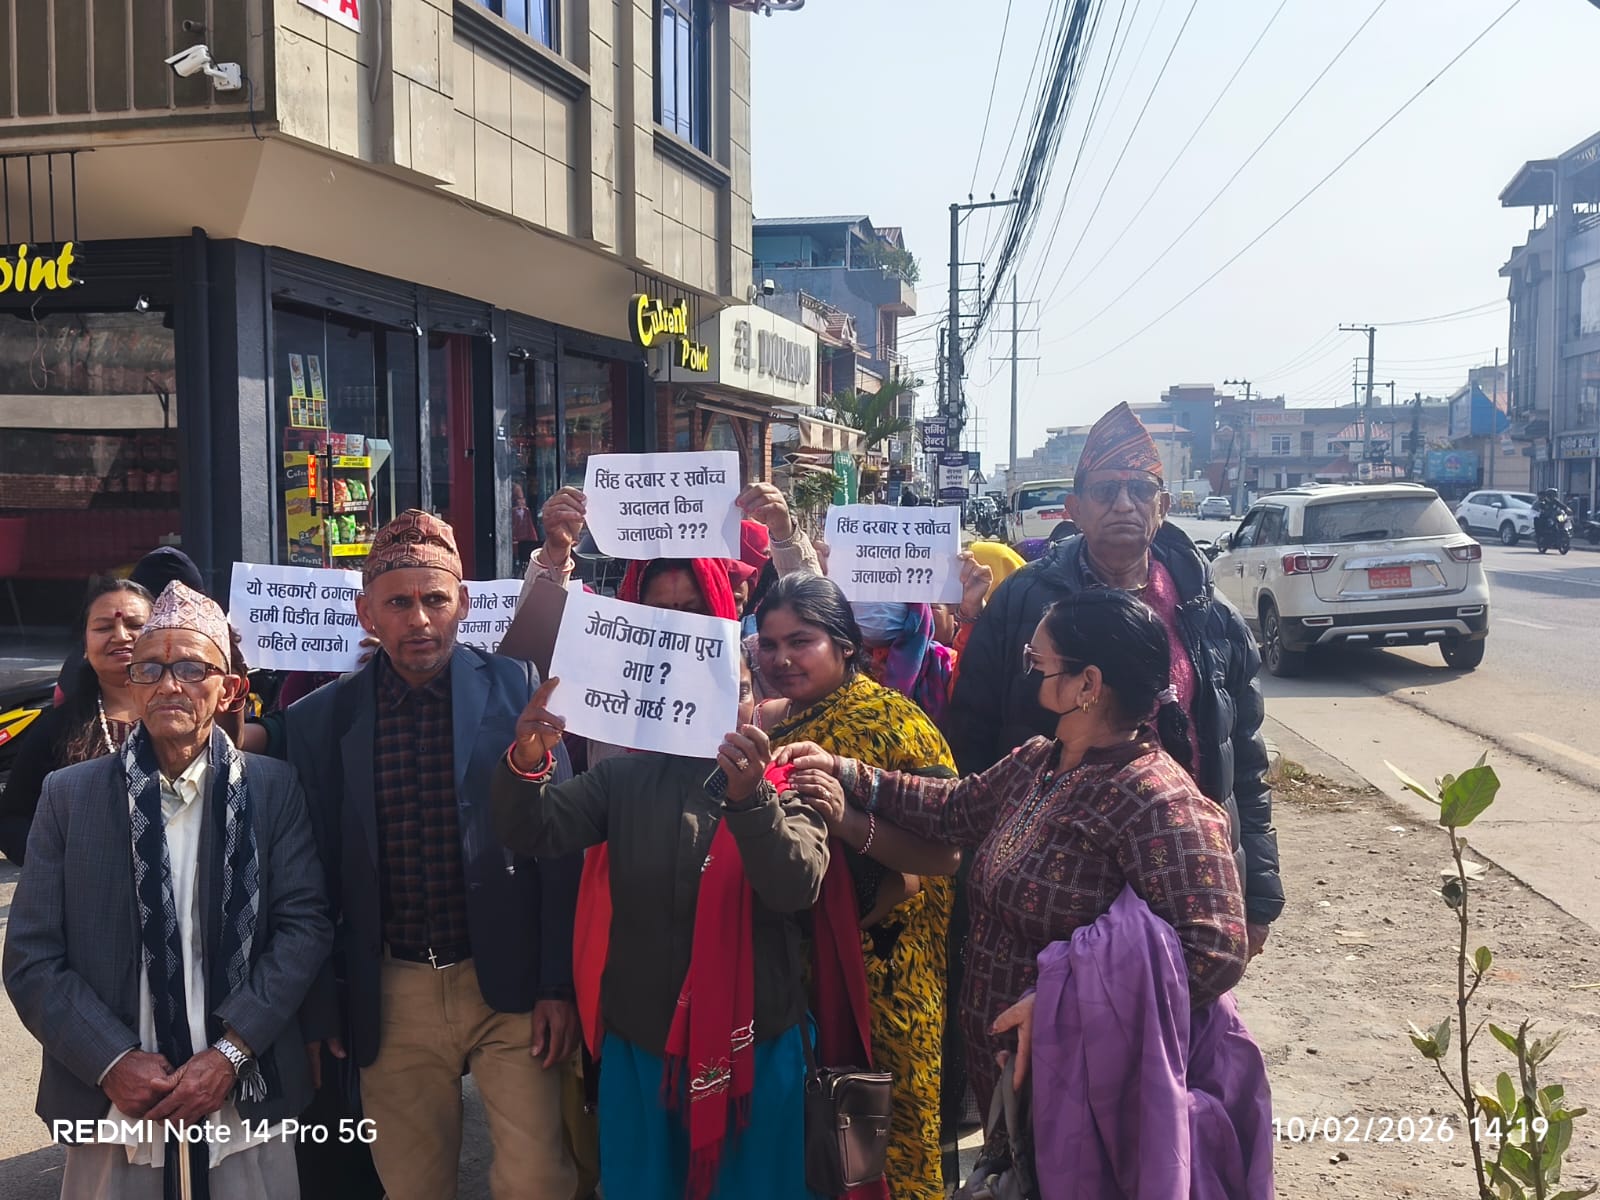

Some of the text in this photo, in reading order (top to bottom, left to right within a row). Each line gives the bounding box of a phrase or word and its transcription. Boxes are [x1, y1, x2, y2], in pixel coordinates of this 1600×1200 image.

[0, 242, 74, 293] oint
[681, 339, 709, 371] Point
[595, 466, 726, 489] सिंह दरबार र सर्वोच्च
[619, 496, 704, 516] अदालत किन
[617, 523, 708, 542] जलाएको ???
[837, 516, 951, 536] सिंह दरबार र सर्वोच्च
[856, 542, 931, 559] अदालत किन
[852, 567, 933, 584] जलाएको ???
[246, 577, 362, 602] यो सहकारी ठगला
[469, 592, 498, 610] ामीले
[249, 605, 359, 627] हामी पिडीत बिचमा
[458, 620, 492, 634] जम्मा
[584, 610, 723, 661] जेनजिका माग पुरा
[257, 631, 297, 651] कहिले
[622, 660, 672, 685] भाए ?
[584, 688, 697, 725] कस्ले गर्छ ??
